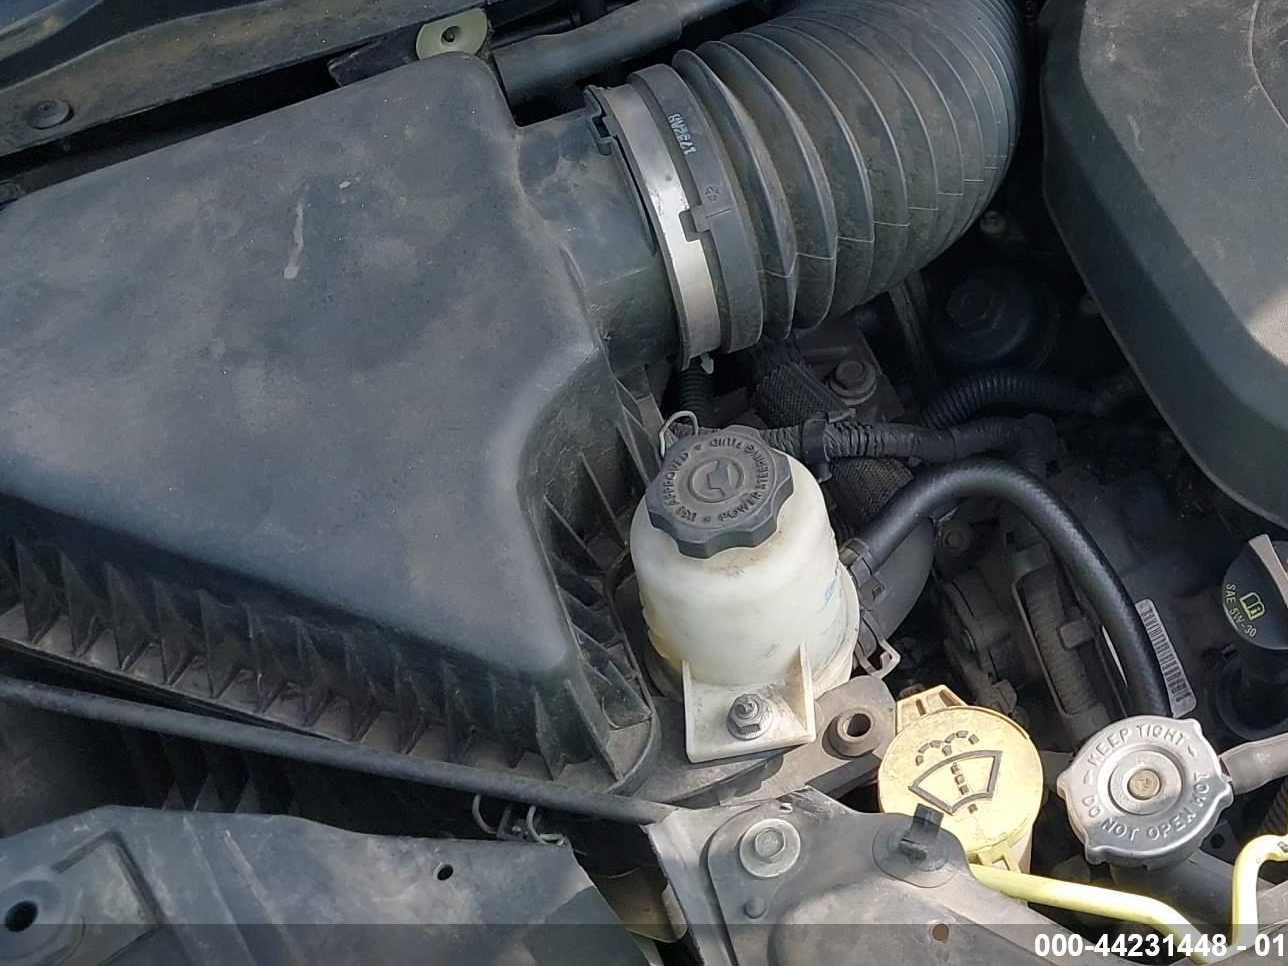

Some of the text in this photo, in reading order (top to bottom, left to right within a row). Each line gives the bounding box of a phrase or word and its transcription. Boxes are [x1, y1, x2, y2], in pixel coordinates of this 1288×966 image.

[1225, 583, 1258, 639] SAE 5W-30
[1087, 724, 1187, 767] KEEP TIGHT
[1082, 771, 1211, 841] DO NOT OPEN HOT
